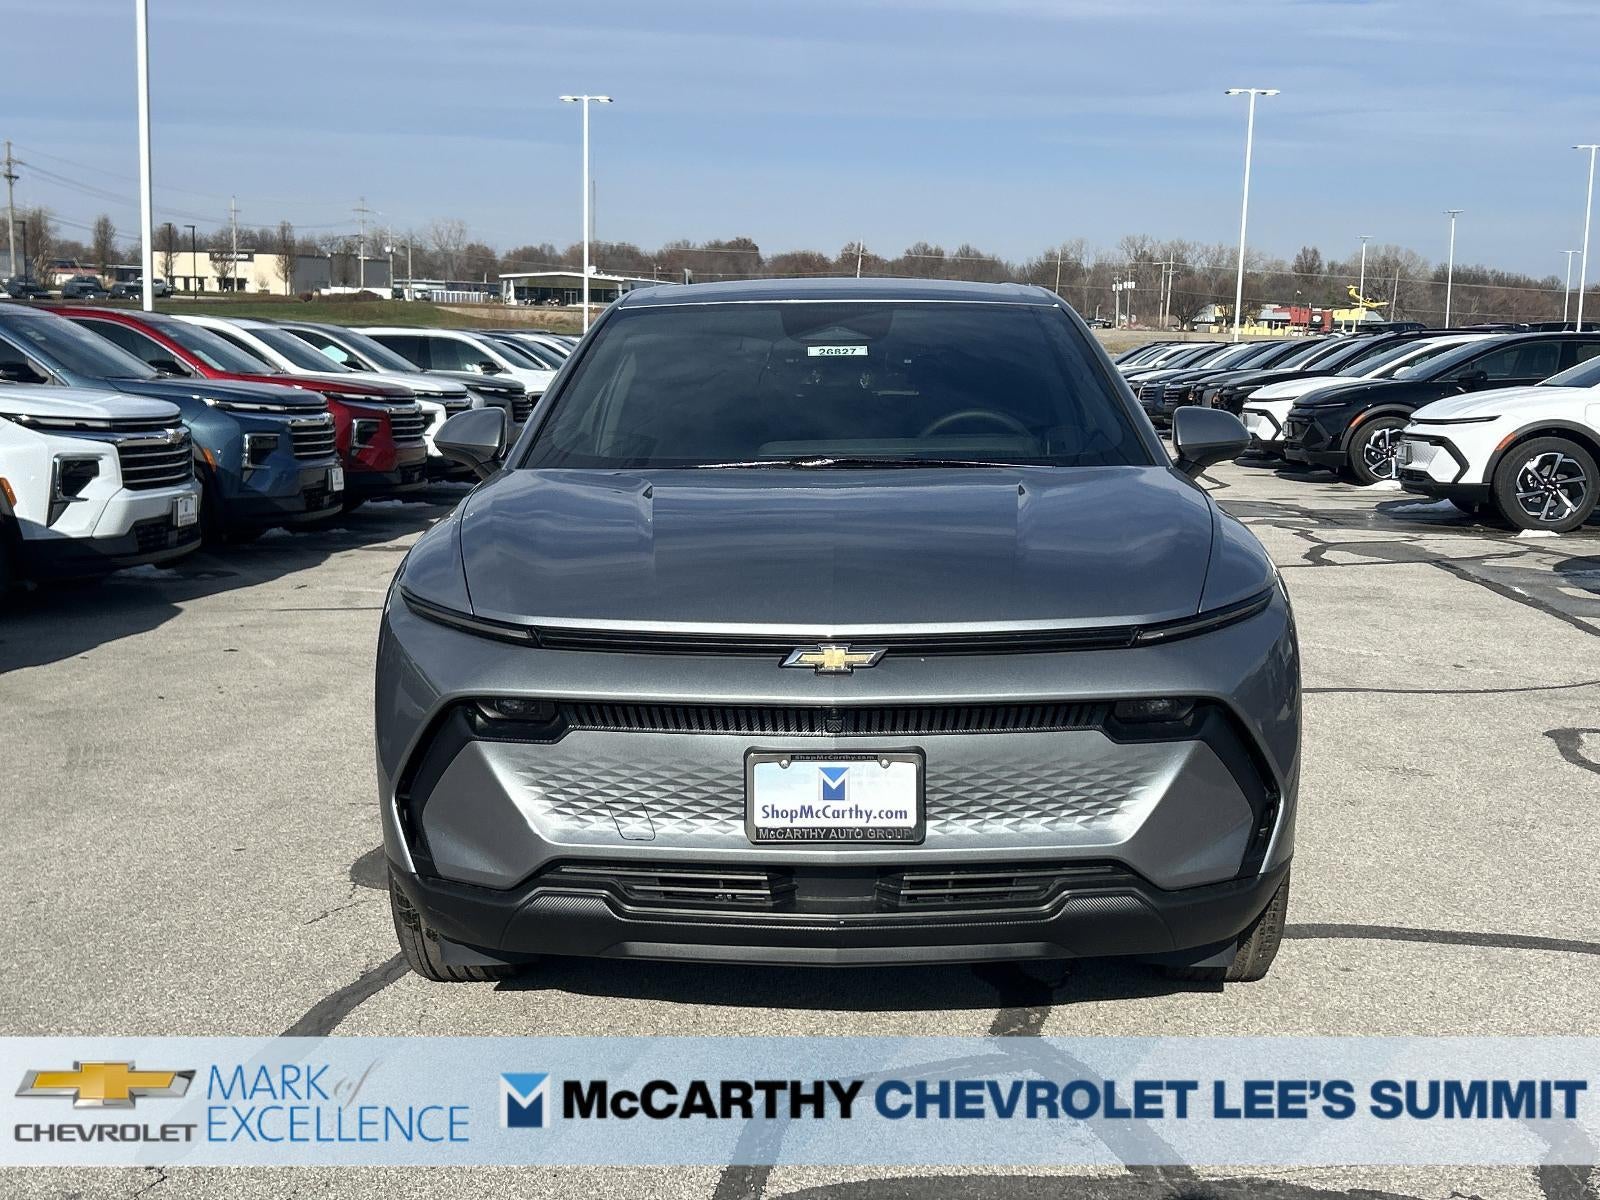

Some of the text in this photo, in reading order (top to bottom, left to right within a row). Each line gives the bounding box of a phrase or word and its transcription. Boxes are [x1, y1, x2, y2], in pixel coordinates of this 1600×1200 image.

[761, 804, 908, 823] ShopMcCarthy.com
[759, 828, 914, 840] McCARTHY AUTO GROUP
